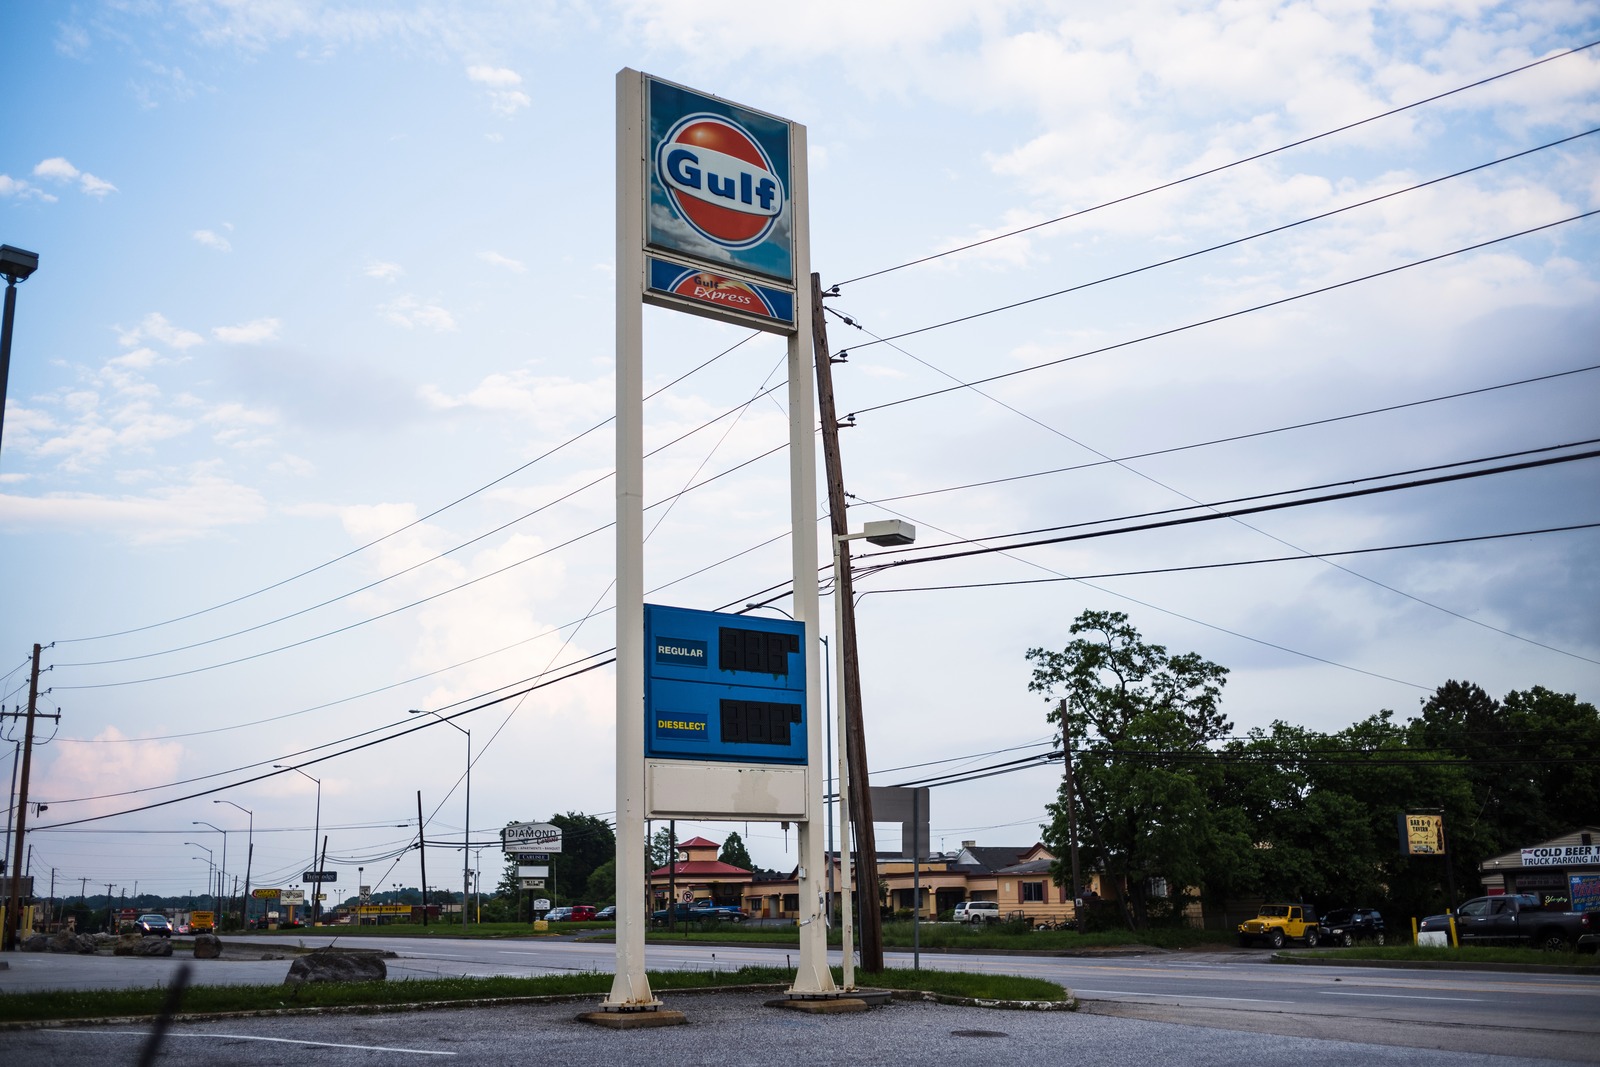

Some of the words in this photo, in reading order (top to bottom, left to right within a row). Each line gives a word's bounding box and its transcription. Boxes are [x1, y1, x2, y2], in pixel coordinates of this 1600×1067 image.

[667, 149, 776, 210] Gulf
[693, 275, 720, 290] Gulf
[658, 645, 703, 657] REGULAR
[658, 720, 706, 731] DIESELECT
[508, 829, 557, 838] DIAMOND
[1534, 848, 1562, 858] COLD
[1565, 846, 1592, 856] BEER
[1524, 857, 1550, 866] TRUCK
[1552, 856, 1588, 865] PARKING
